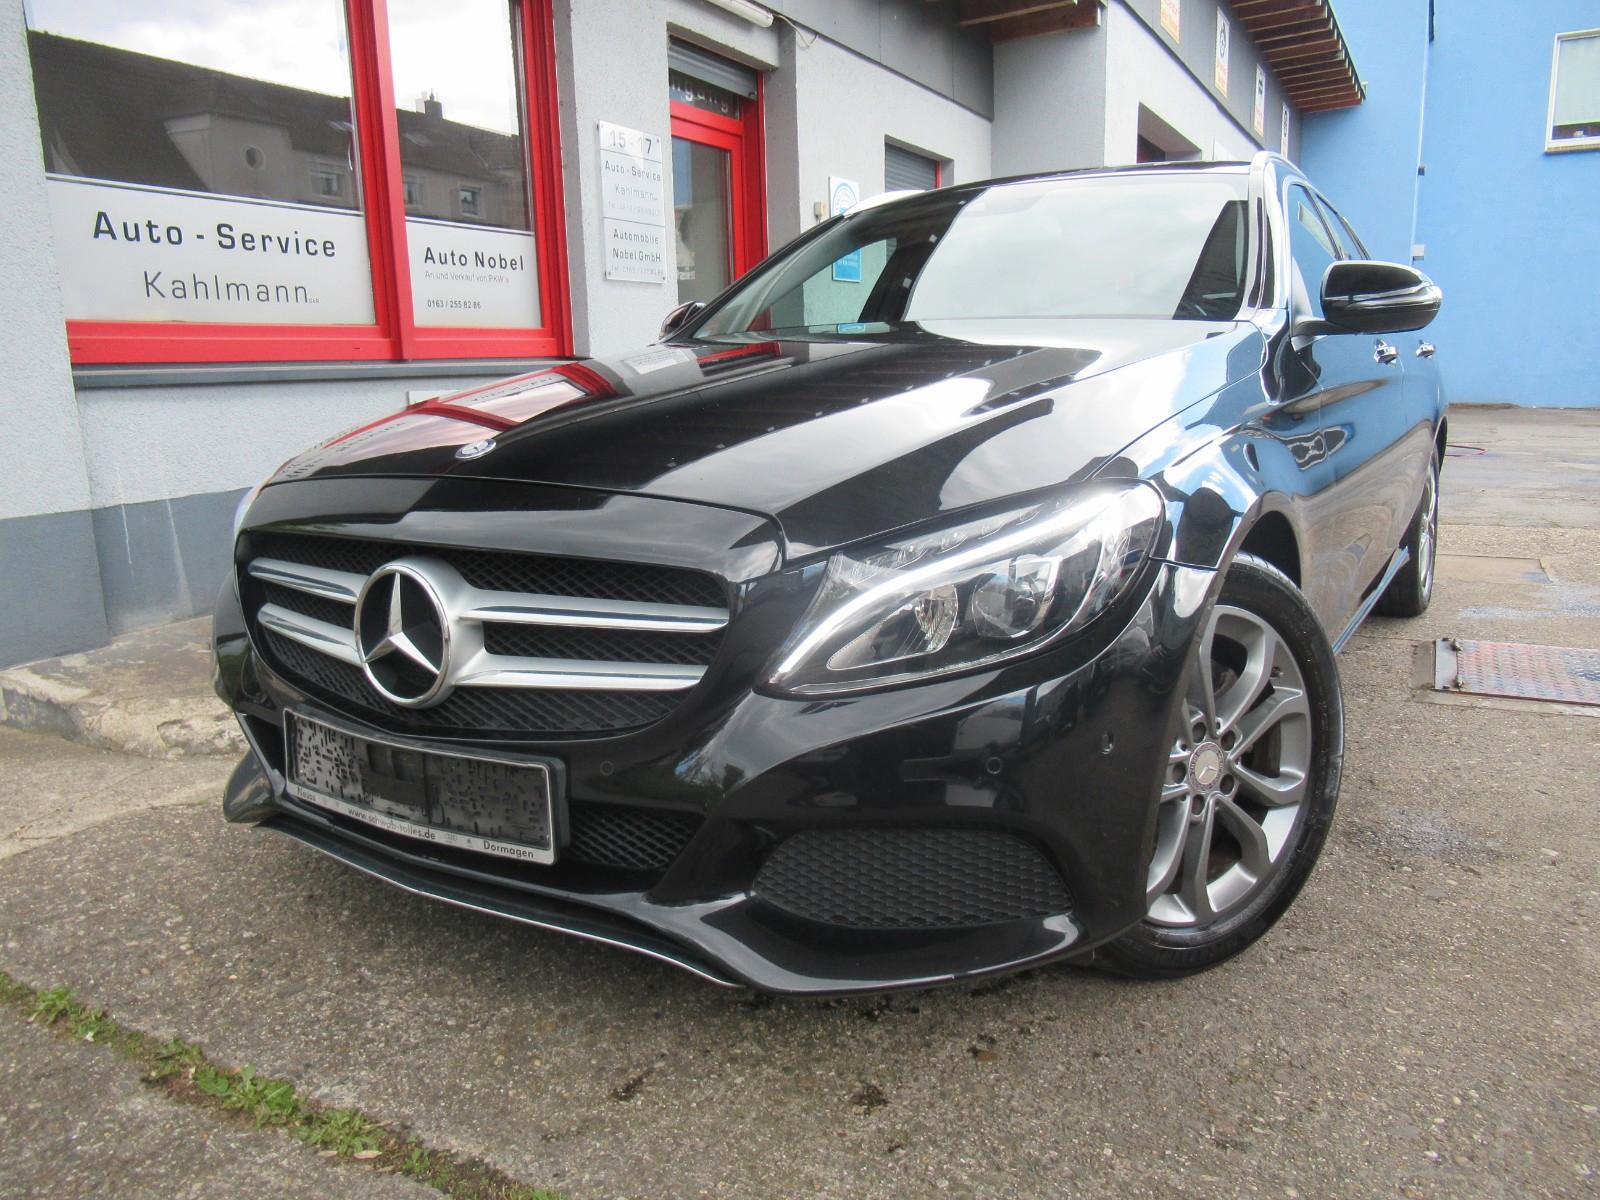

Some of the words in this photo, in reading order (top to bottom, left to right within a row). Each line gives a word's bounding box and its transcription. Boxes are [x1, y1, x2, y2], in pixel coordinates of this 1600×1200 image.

[610, 129, 626, 149] 15
[605, 160, 625, 175] Auto
[631, 166, 661, 182] Service
[615, 183, 655, 200] Kahlmann
[93, 210, 184, 246] Auto
[216, 223, 337, 258] Service
[613, 228, 659, 245] Automobile
[424, 246, 468, 267] Auto
[474, 251, 525, 271] Nobel
[612, 247, 637, 260] Nobel
[638, 250, 661, 263] GmbH
[143, 271, 309, 304] Kahlmann
[427, 299, 444, 308] 0163
[449, 300, 463, 309] 255
[483, 840, 534, 859] Dormagen
